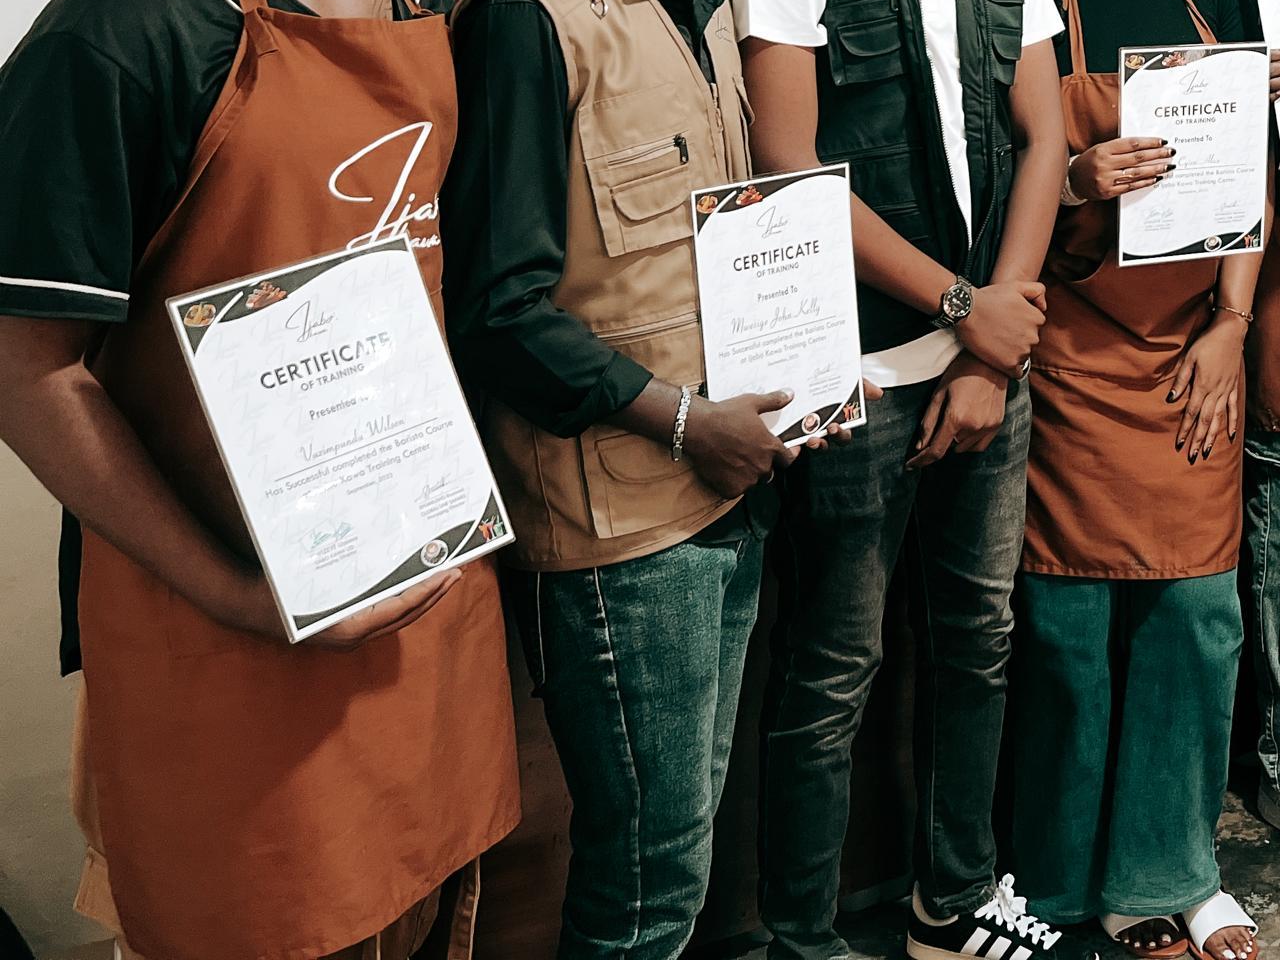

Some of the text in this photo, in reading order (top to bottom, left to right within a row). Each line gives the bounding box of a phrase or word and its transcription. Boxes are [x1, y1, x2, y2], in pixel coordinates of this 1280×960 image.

[1154, 101, 1237, 118] CERTIFICATE
[1174, 135, 1204, 144] Presented
[733, 240, 820, 272] CERTIFICATE
[756, 261, 800, 278] OF TRAINING
[757, 285, 798, 302] Presented To
[260, 332, 390, 389] CERTIFICATE
[300, 363, 365, 391] OF TRAINING
[264, 486, 284, 499] Has
[285, 465, 330, 491] Successful
[332, 447, 378, 474] completed
[425, 419, 454, 436] Course
[368, 454, 402, 475] Training
[402, 443, 431, 460] Center
